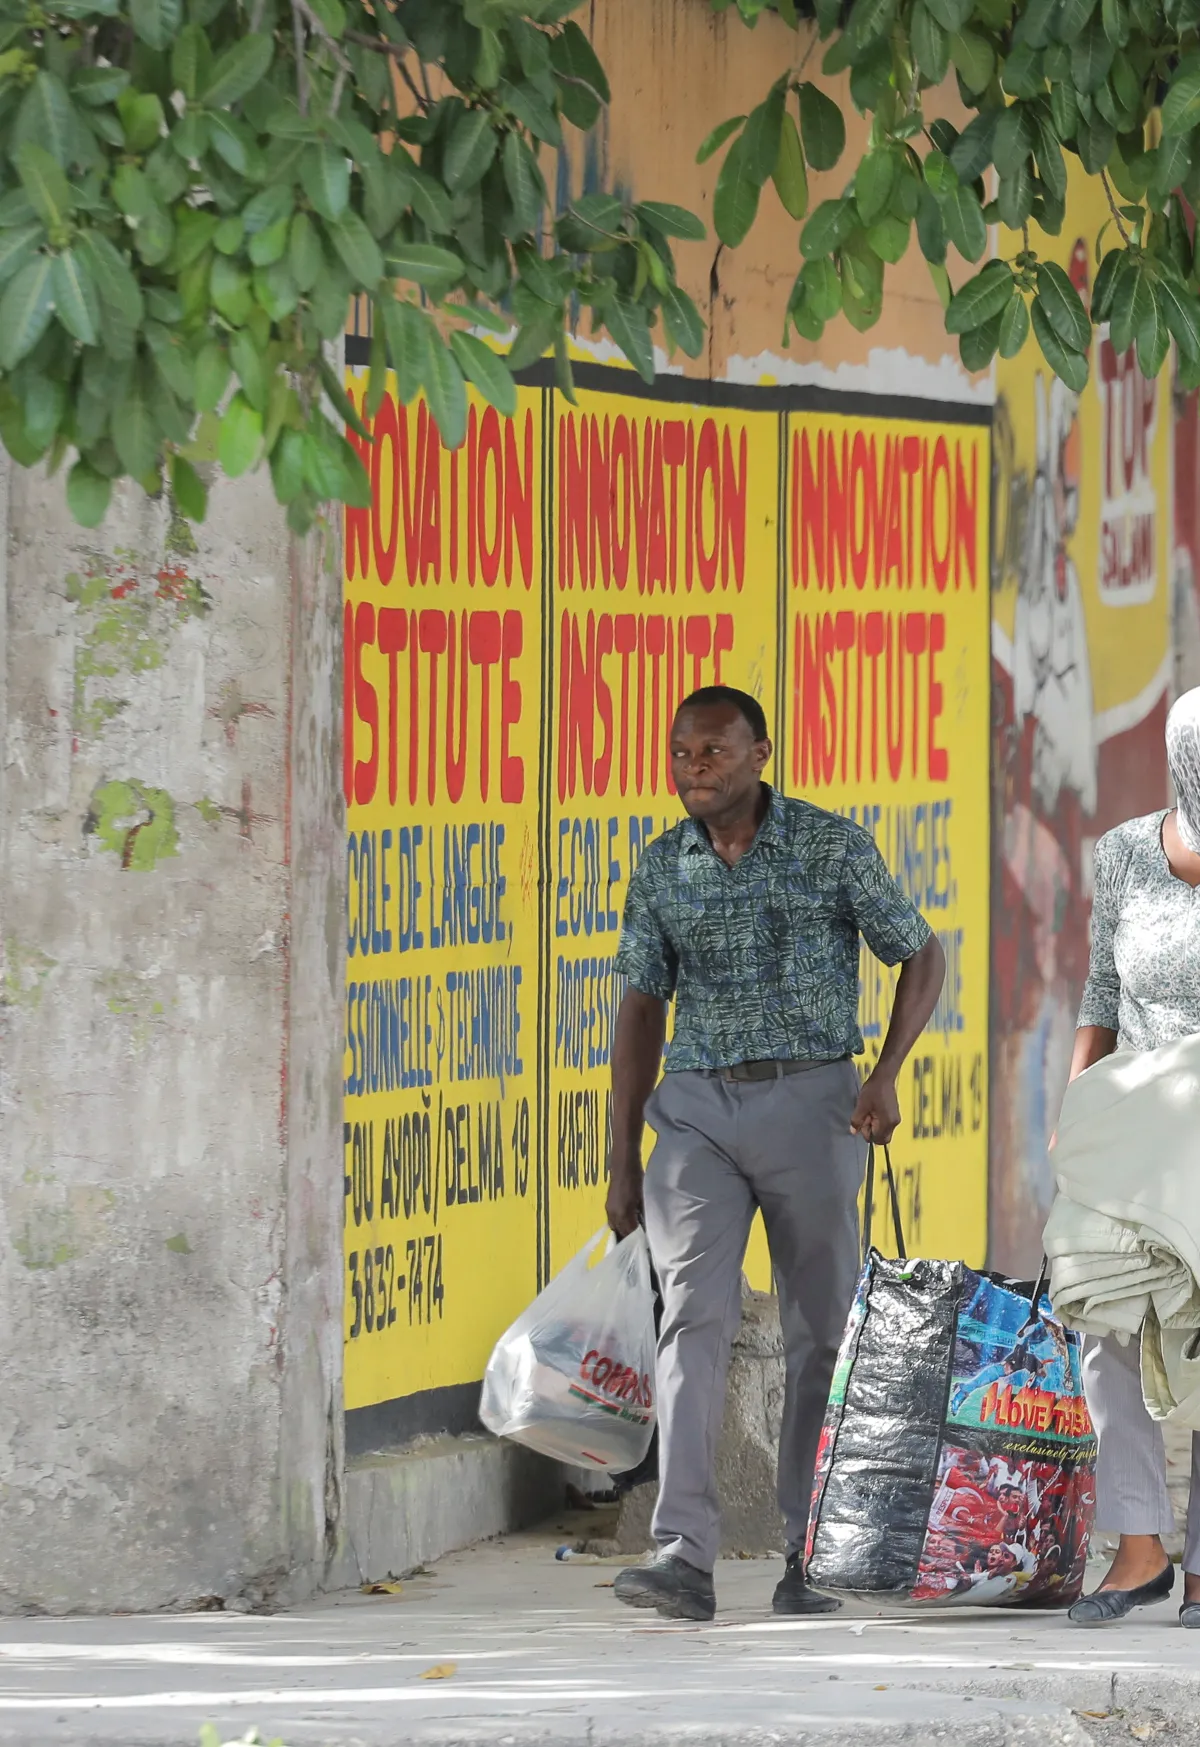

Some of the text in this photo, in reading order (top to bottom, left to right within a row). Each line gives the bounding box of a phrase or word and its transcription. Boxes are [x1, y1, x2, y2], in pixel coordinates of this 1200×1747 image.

[558, 410, 747, 596] INNOVATION
[792, 427, 977, 595] INNOVATION
[792, 611, 949, 789] INSTITUTE
[399, 824, 424, 953] DE
[556, 816, 620, 938] ECOLE
[343, 977, 433, 1098] SSIONNELLE
[446, 964, 523, 1101] TECHNIQUE
[512, 1096, 530, 1198] 19
[558, 1088, 599, 1191] KAFOU
[348, 1233, 444, 1338] 3832-7474
[994, 1386, 1055, 1433] LOVE
